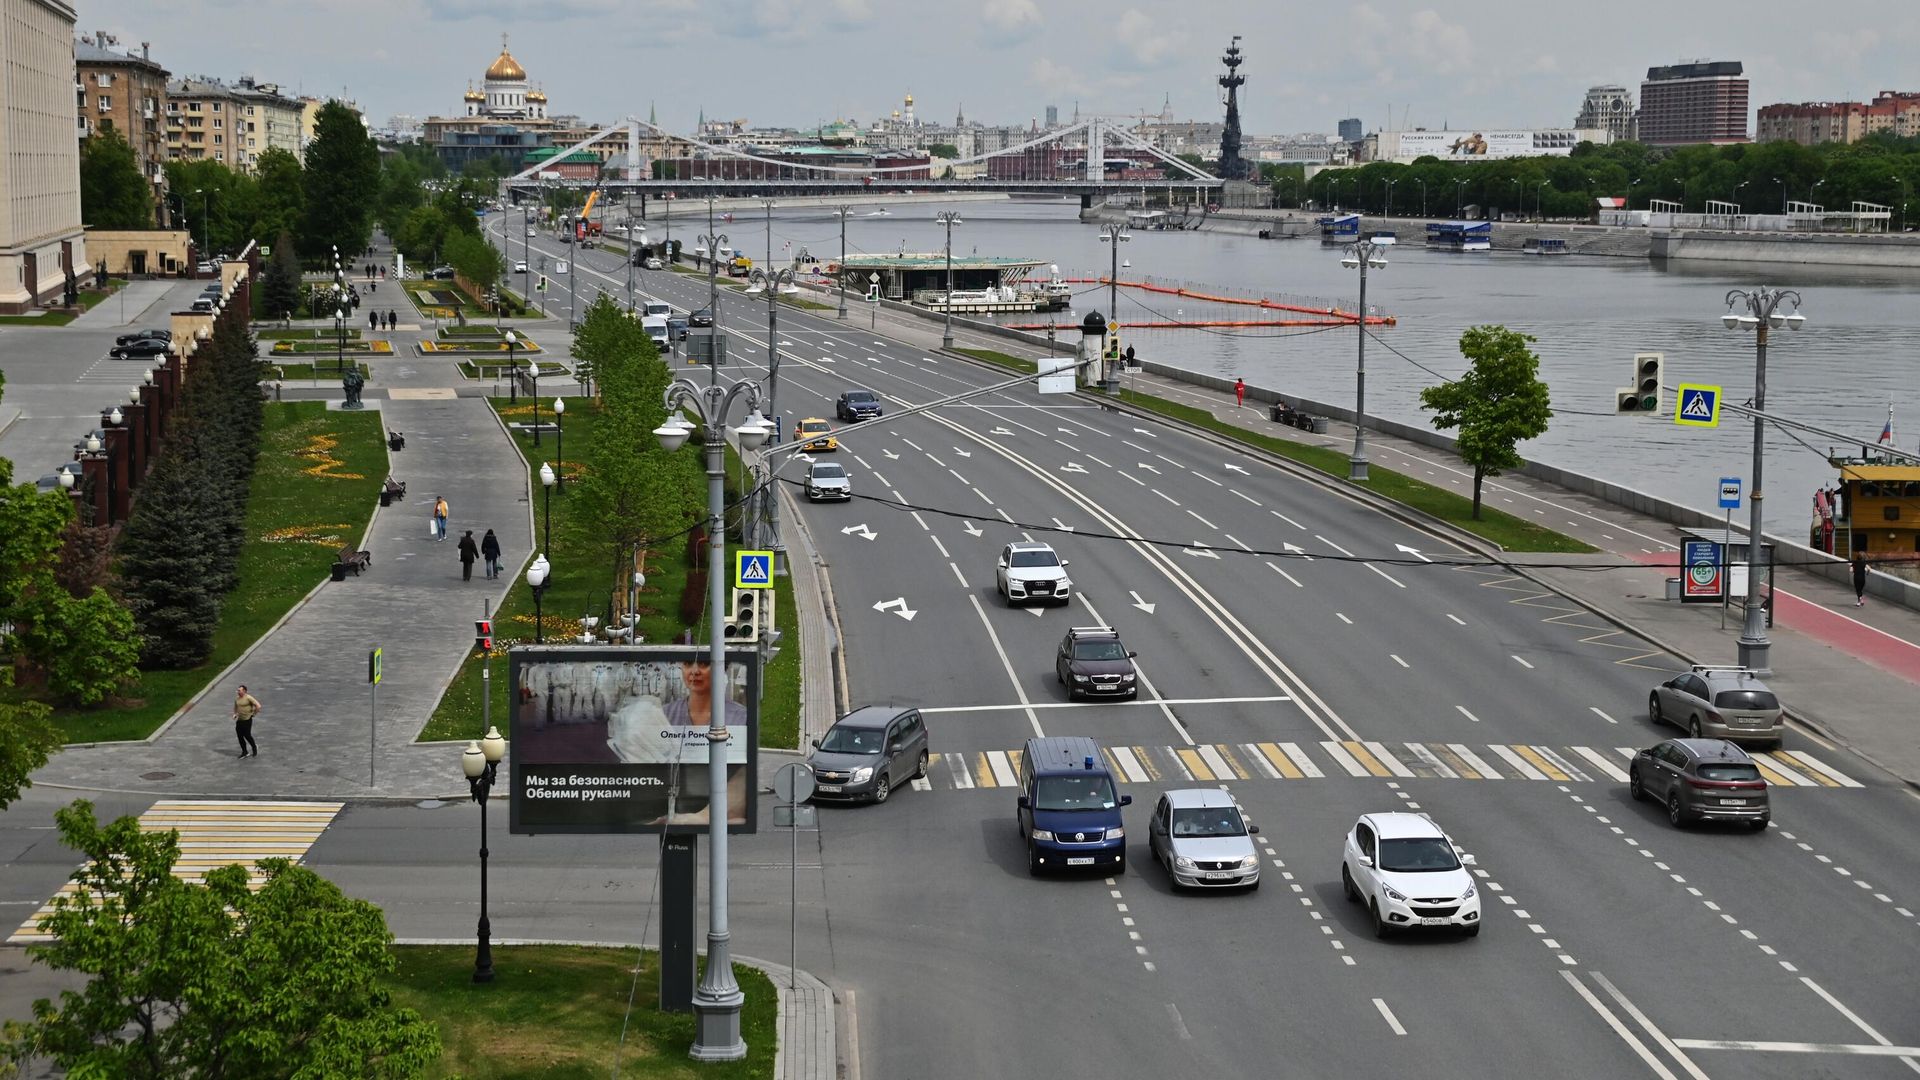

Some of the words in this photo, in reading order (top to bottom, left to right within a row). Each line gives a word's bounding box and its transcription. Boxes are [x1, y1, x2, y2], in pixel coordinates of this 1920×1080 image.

[1695, 566, 1712, 576] 65+
[660, 730, 686, 739] Ольга
[526, 775, 549, 786] Мы
[551, 777, 566, 786] за
[568, 774, 665, 786] безопасность.
[526, 787, 580, 799] Обеими
[581, 789, 631, 801] руками
